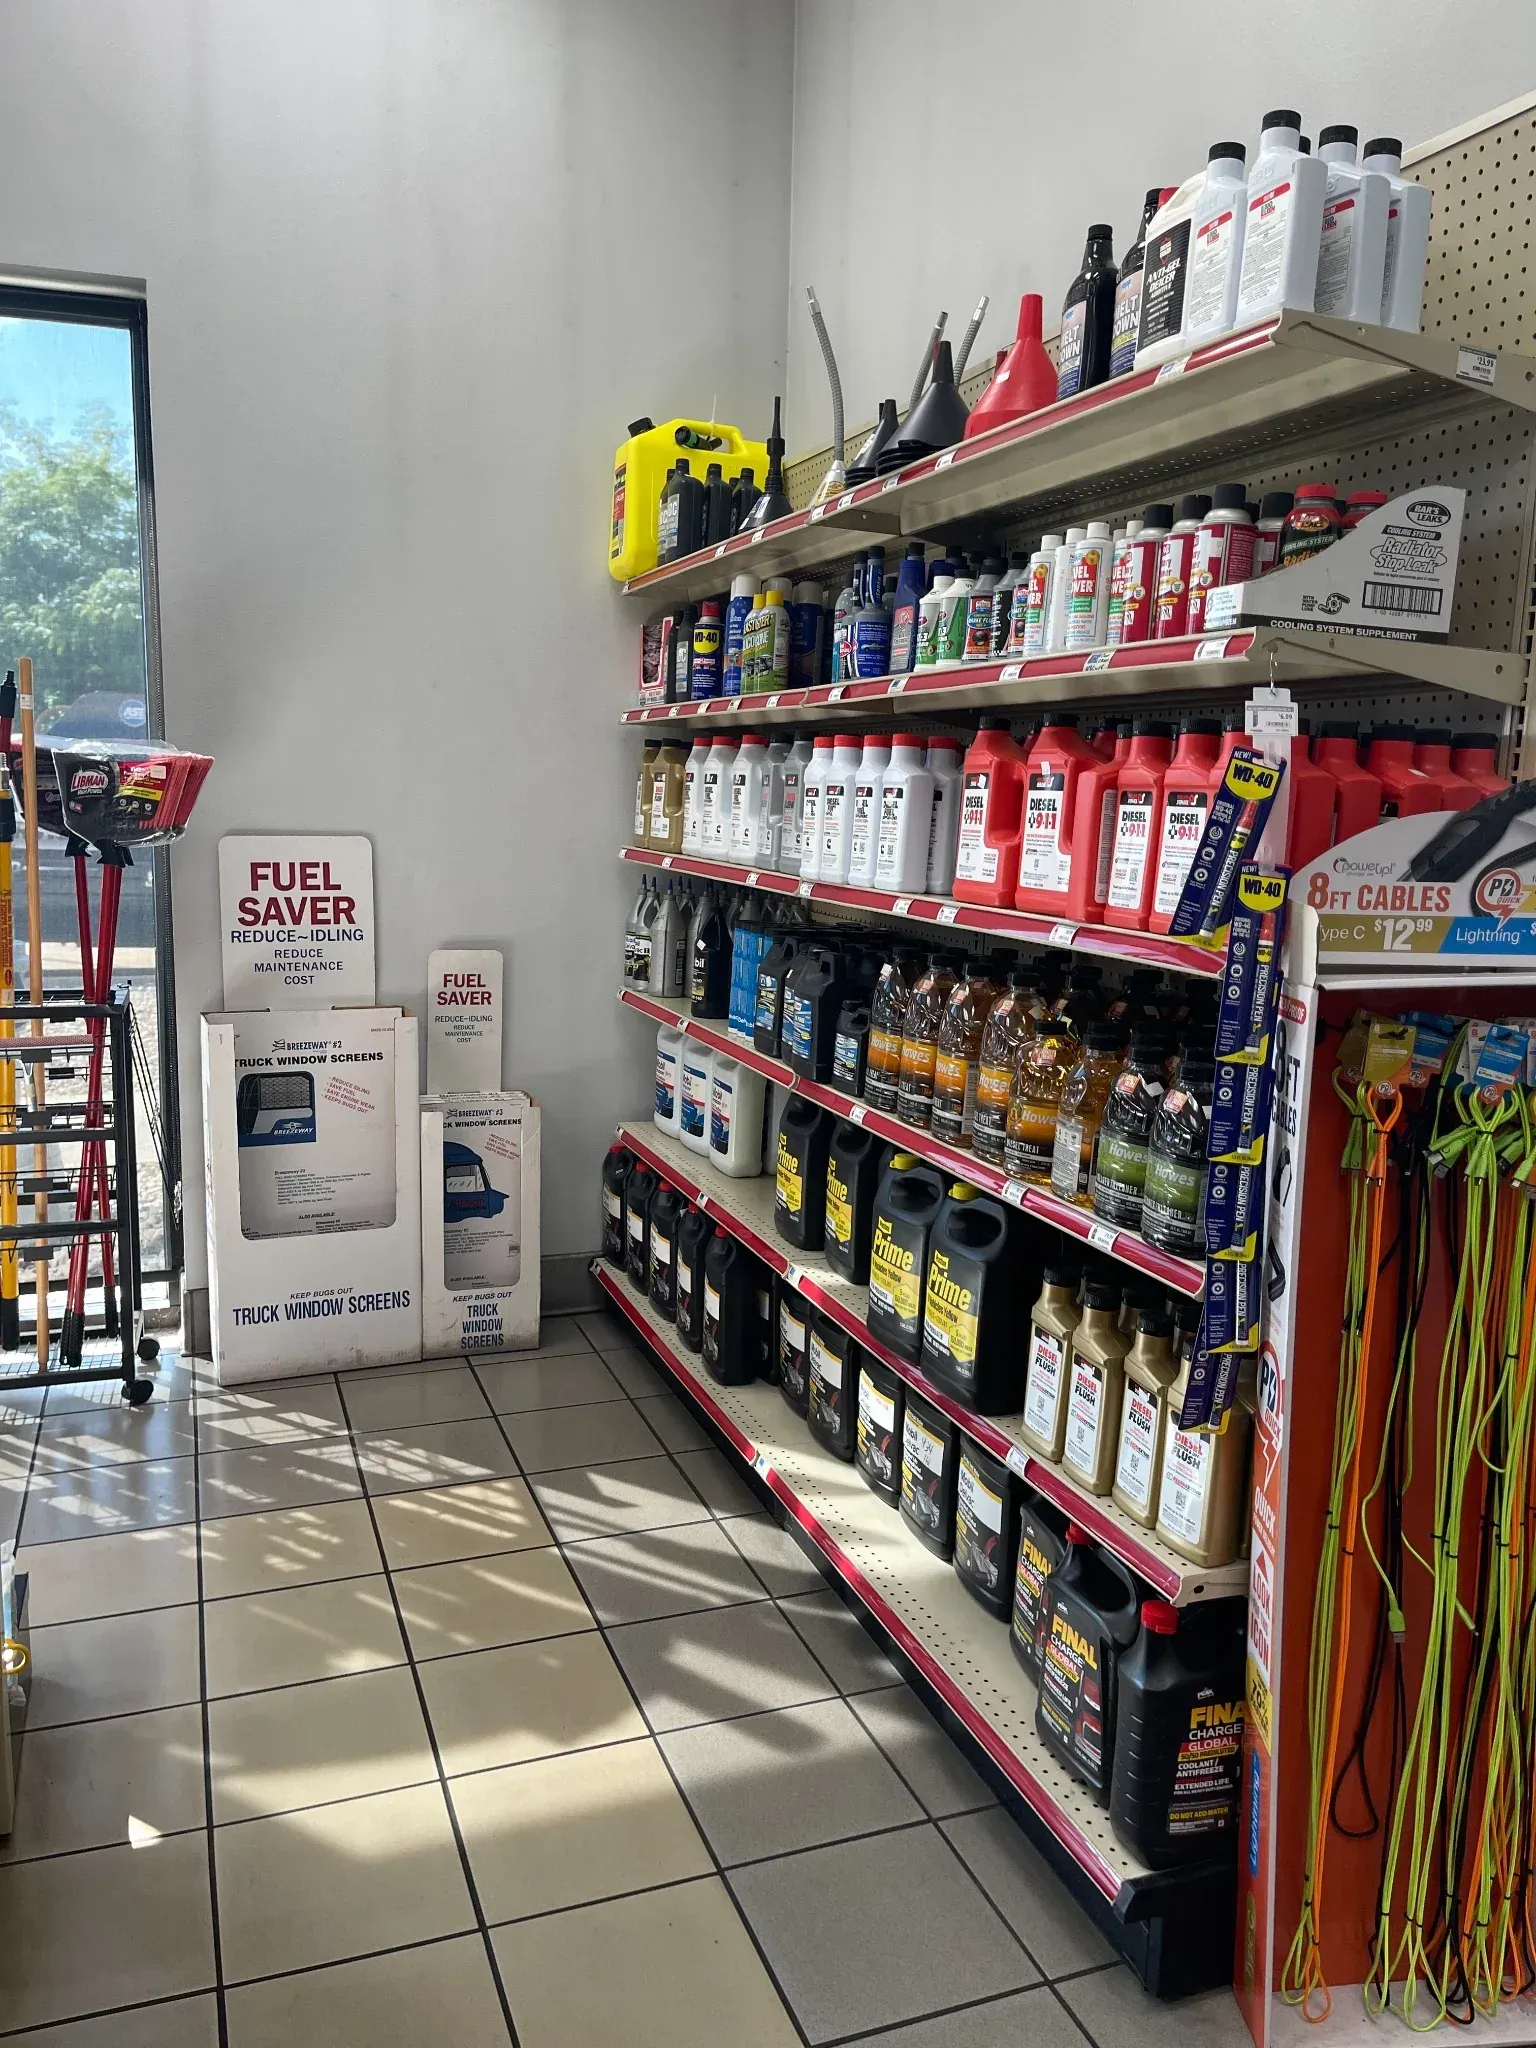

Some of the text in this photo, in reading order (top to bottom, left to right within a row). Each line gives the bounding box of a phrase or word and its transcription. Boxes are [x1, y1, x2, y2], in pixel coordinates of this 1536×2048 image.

[1414, 505, 1440, 515] BAR'S
[1387, 526, 1437, 539] COOLING SYSTEM
[1381, 537, 1443, 558] Radiator
[1270, 619, 1418, 641] COOLING SYSTEM SUPPLEMENT
[1233, 750, 1251, 759] NEW!
[72, 774, 105, 789] LIBMAN
[1233, 763, 1274, 789] WD-40
[966, 796, 984, 808] DIESEL
[1030, 798, 1057, 811] DIESEL
[1122, 811, 1147, 822] DIESEL
[1169, 813, 1199, 825] DIESEL
[250, 861, 342, 891] FUEL
[1212, 850, 1238, 907] PRECISION PEN
[1241, 864, 1257, 873] NEW!
[1244, 877, 1282, 899] WD-40
[1357, 884, 1451, 912] CABLES
[237, 896, 356, 927] SAVER
[1353, 925, 1365, 940] C
[1456, 928, 1520, 945] Lightning
[274, 948, 324, 958] REDUCE
[254, 961, 344, 973] MAINTENANCE
[284, 975, 315, 985] COST
[443, 973, 488, 989] FUEL
[437, 991, 492, 1006] SAVER
[1255, 964, 1270, 1022] PRECISION PEN
[287, 1040, 342, 1050] BREEZEWAY #2
[235, 1052, 384, 1067] TRUCK WINDOW SCREENS
[1242, 1065, 1259, 1125] PRECISION PEN
[458, 1109, 491, 1117] BREEZEWAY
[1021, 1110, 1057, 1126] Howe
[1155, 1164, 1195, 1187] Howes
[1236, 1204, 1247, 1223] PEN
[873, 1229, 914, 1271] Prime
[290, 1287, 353, 1300] KEEP BUGS OUT
[453, 1291, 512, 1302] KEEP BUGS OUT
[929, 1262, 972, 1311] Prime
[1238, 1262, 1248, 1319] PRECISION PEN
[233, 1290, 411, 1326] TRUCK WINDOW SCREENS
[467, 1303, 499, 1318] TRUCK
[462, 1318, 503, 1334] WINDOW
[461, 1333, 504, 1350] SCREENS
[1038, 1345, 1058, 1364] DIESEL
[1035, 1356, 1056, 1377] FLUSH
[1077, 1372, 1097, 1393] DIESEL
[1213, 1353, 1233, 1404] PRECISION PEN
[1075, 1385, 1095, 1406] FLUSH
[1131, 1398, 1152, 1421] DIESEL
[905, 1421, 918, 1441] Mobil
[1128, 1411, 1151, 1434] FLUSH
[1265, 1408, 1281, 1443] QUICK
[1174, 1431, 1203, 1456] DIESEL
[1172, 1446, 1200, 1470] FLUSH
[1254, 1488, 1276, 1538] QUICK
[1021, 1555, 1045, 1585] CHARGE
[1252, 1564, 1271, 1621] LOOK
[1050, 1634, 1084, 1668] CHARGE
[1052, 1613, 1098, 1671] FINAL
[1250, 1613, 1269, 1672] ICON
[1049, 1642, 1079, 1676] GLOBAL
[1197, 1689, 1214, 1699] PEAK
[1190, 1701, 1247, 1729] FINA
[1189, 1723, 1242, 1741] CHARGE
[1180, 1747, 1236, 1760] 50/50 PREDILUTED
[1189, 1736, 1237, 1752] GLOBAL
[1176, 1765, 1224, 1778] ANTIFREEZE
[1178, 1759, 1214, 1770] COOLANT
[1174, 1778, 1230, 1791] EXTENDED LIFE
[1169, 1812, 1180, 1820] DO
[1181, 1811, 1194, 1819] NOT
